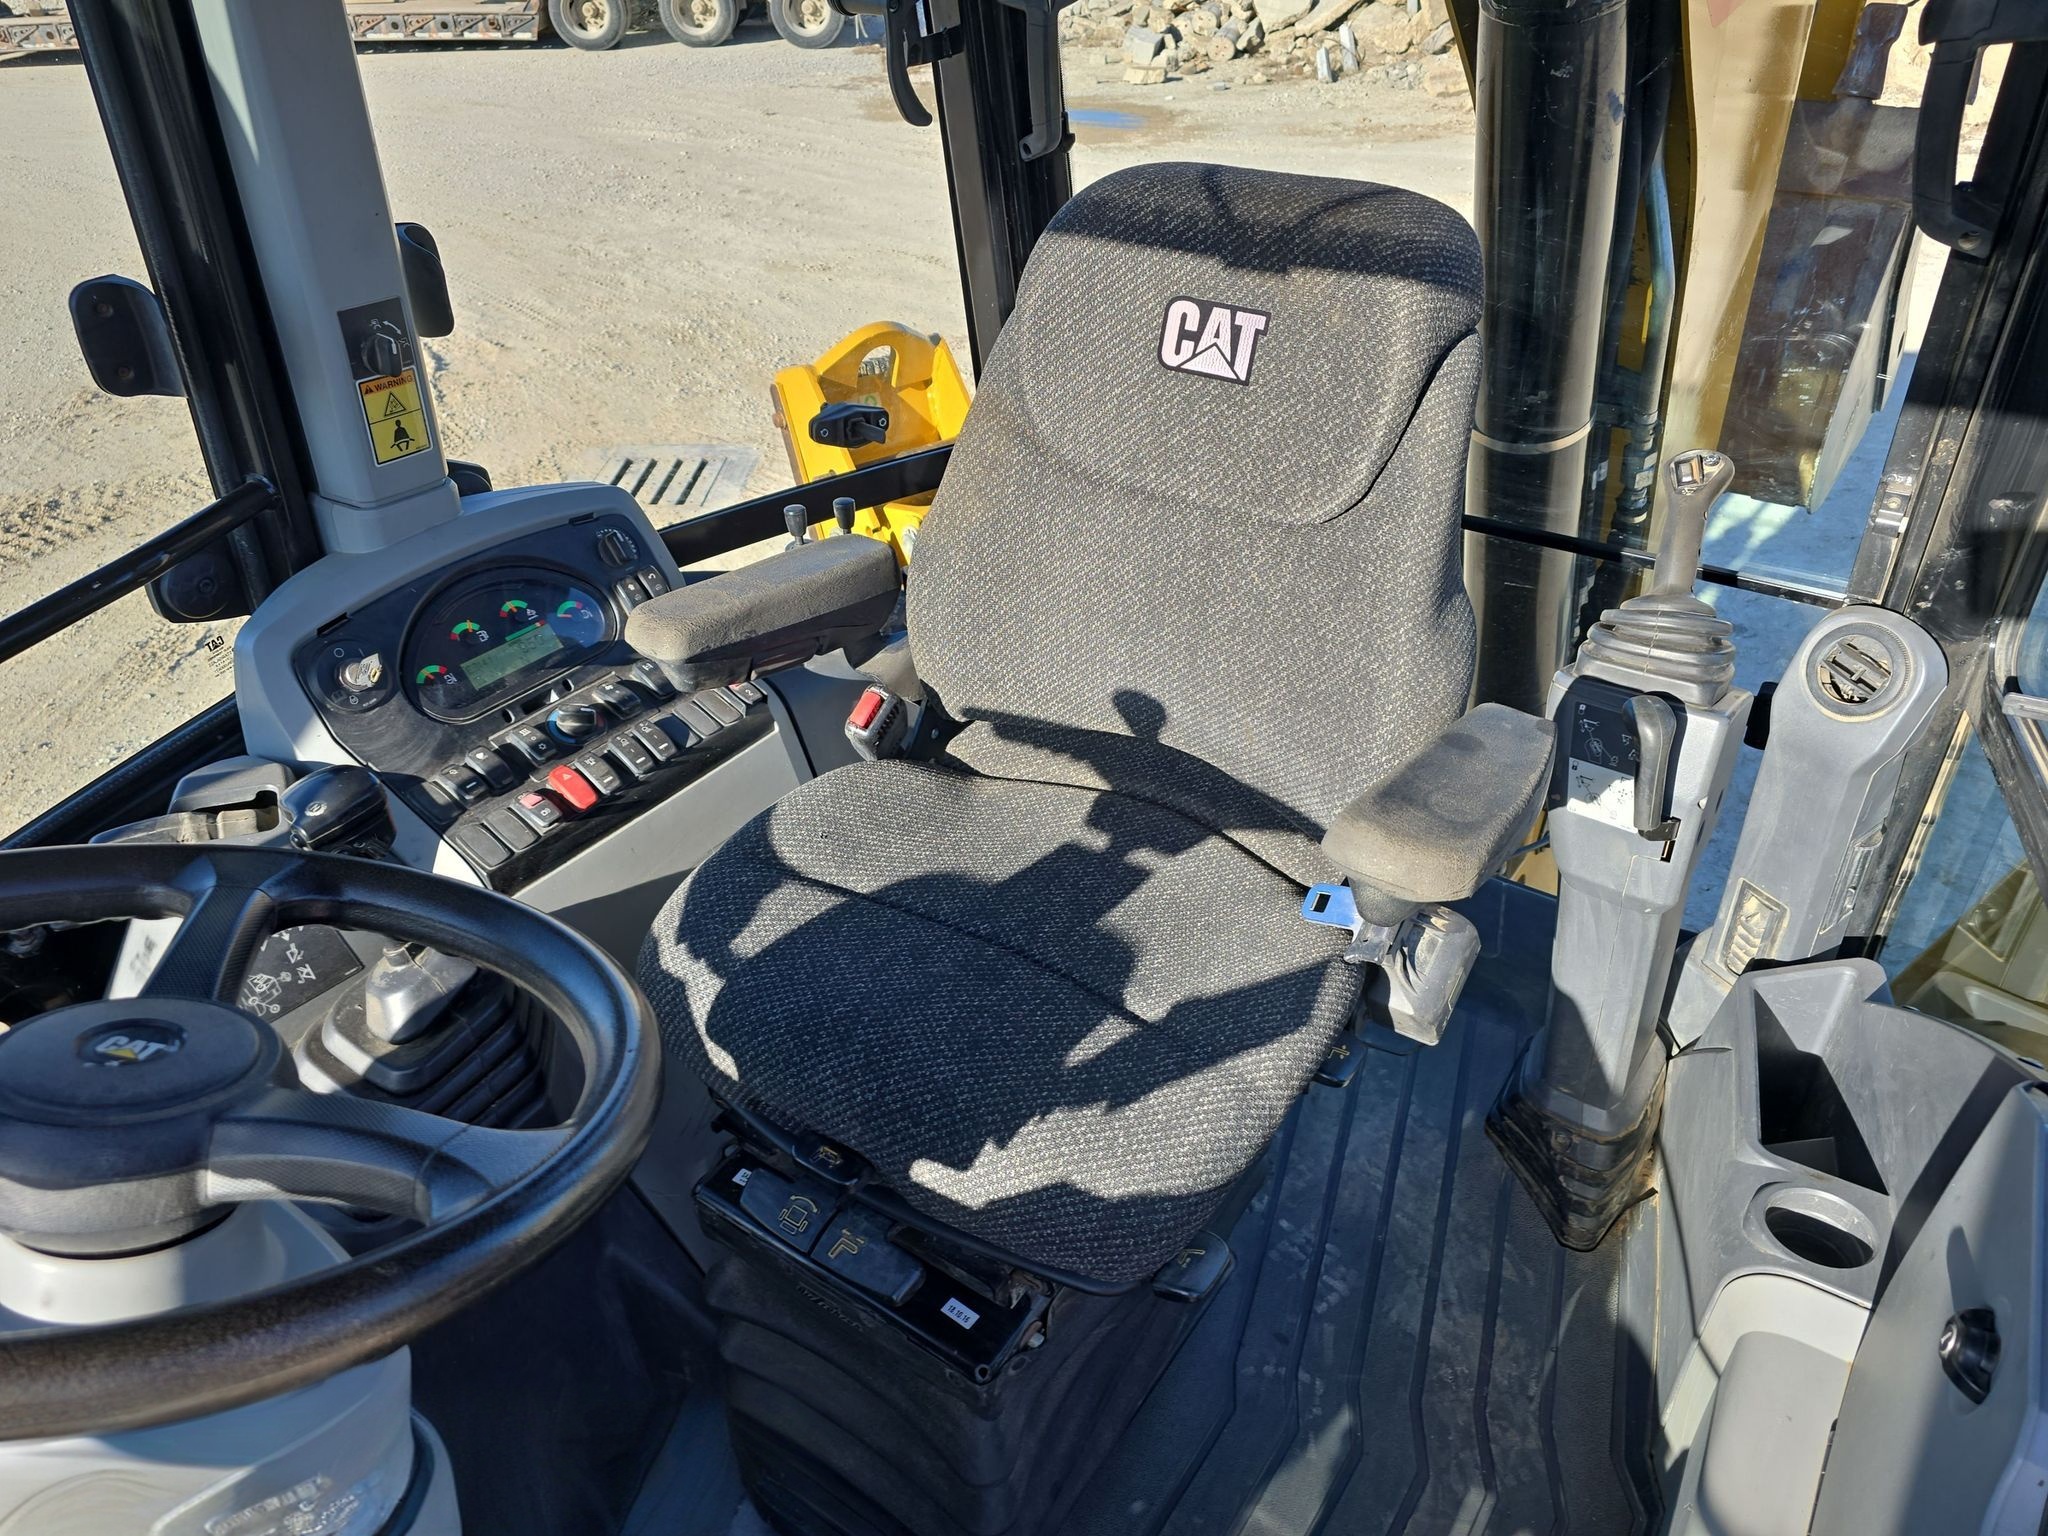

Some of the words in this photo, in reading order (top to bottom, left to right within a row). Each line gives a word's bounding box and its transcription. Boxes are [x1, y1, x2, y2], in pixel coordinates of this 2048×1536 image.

[1161, 300, 1267, 381] CAT
[374, 374, 413, 392] WARNING
[95, 1035, 167, 1061] CAT
